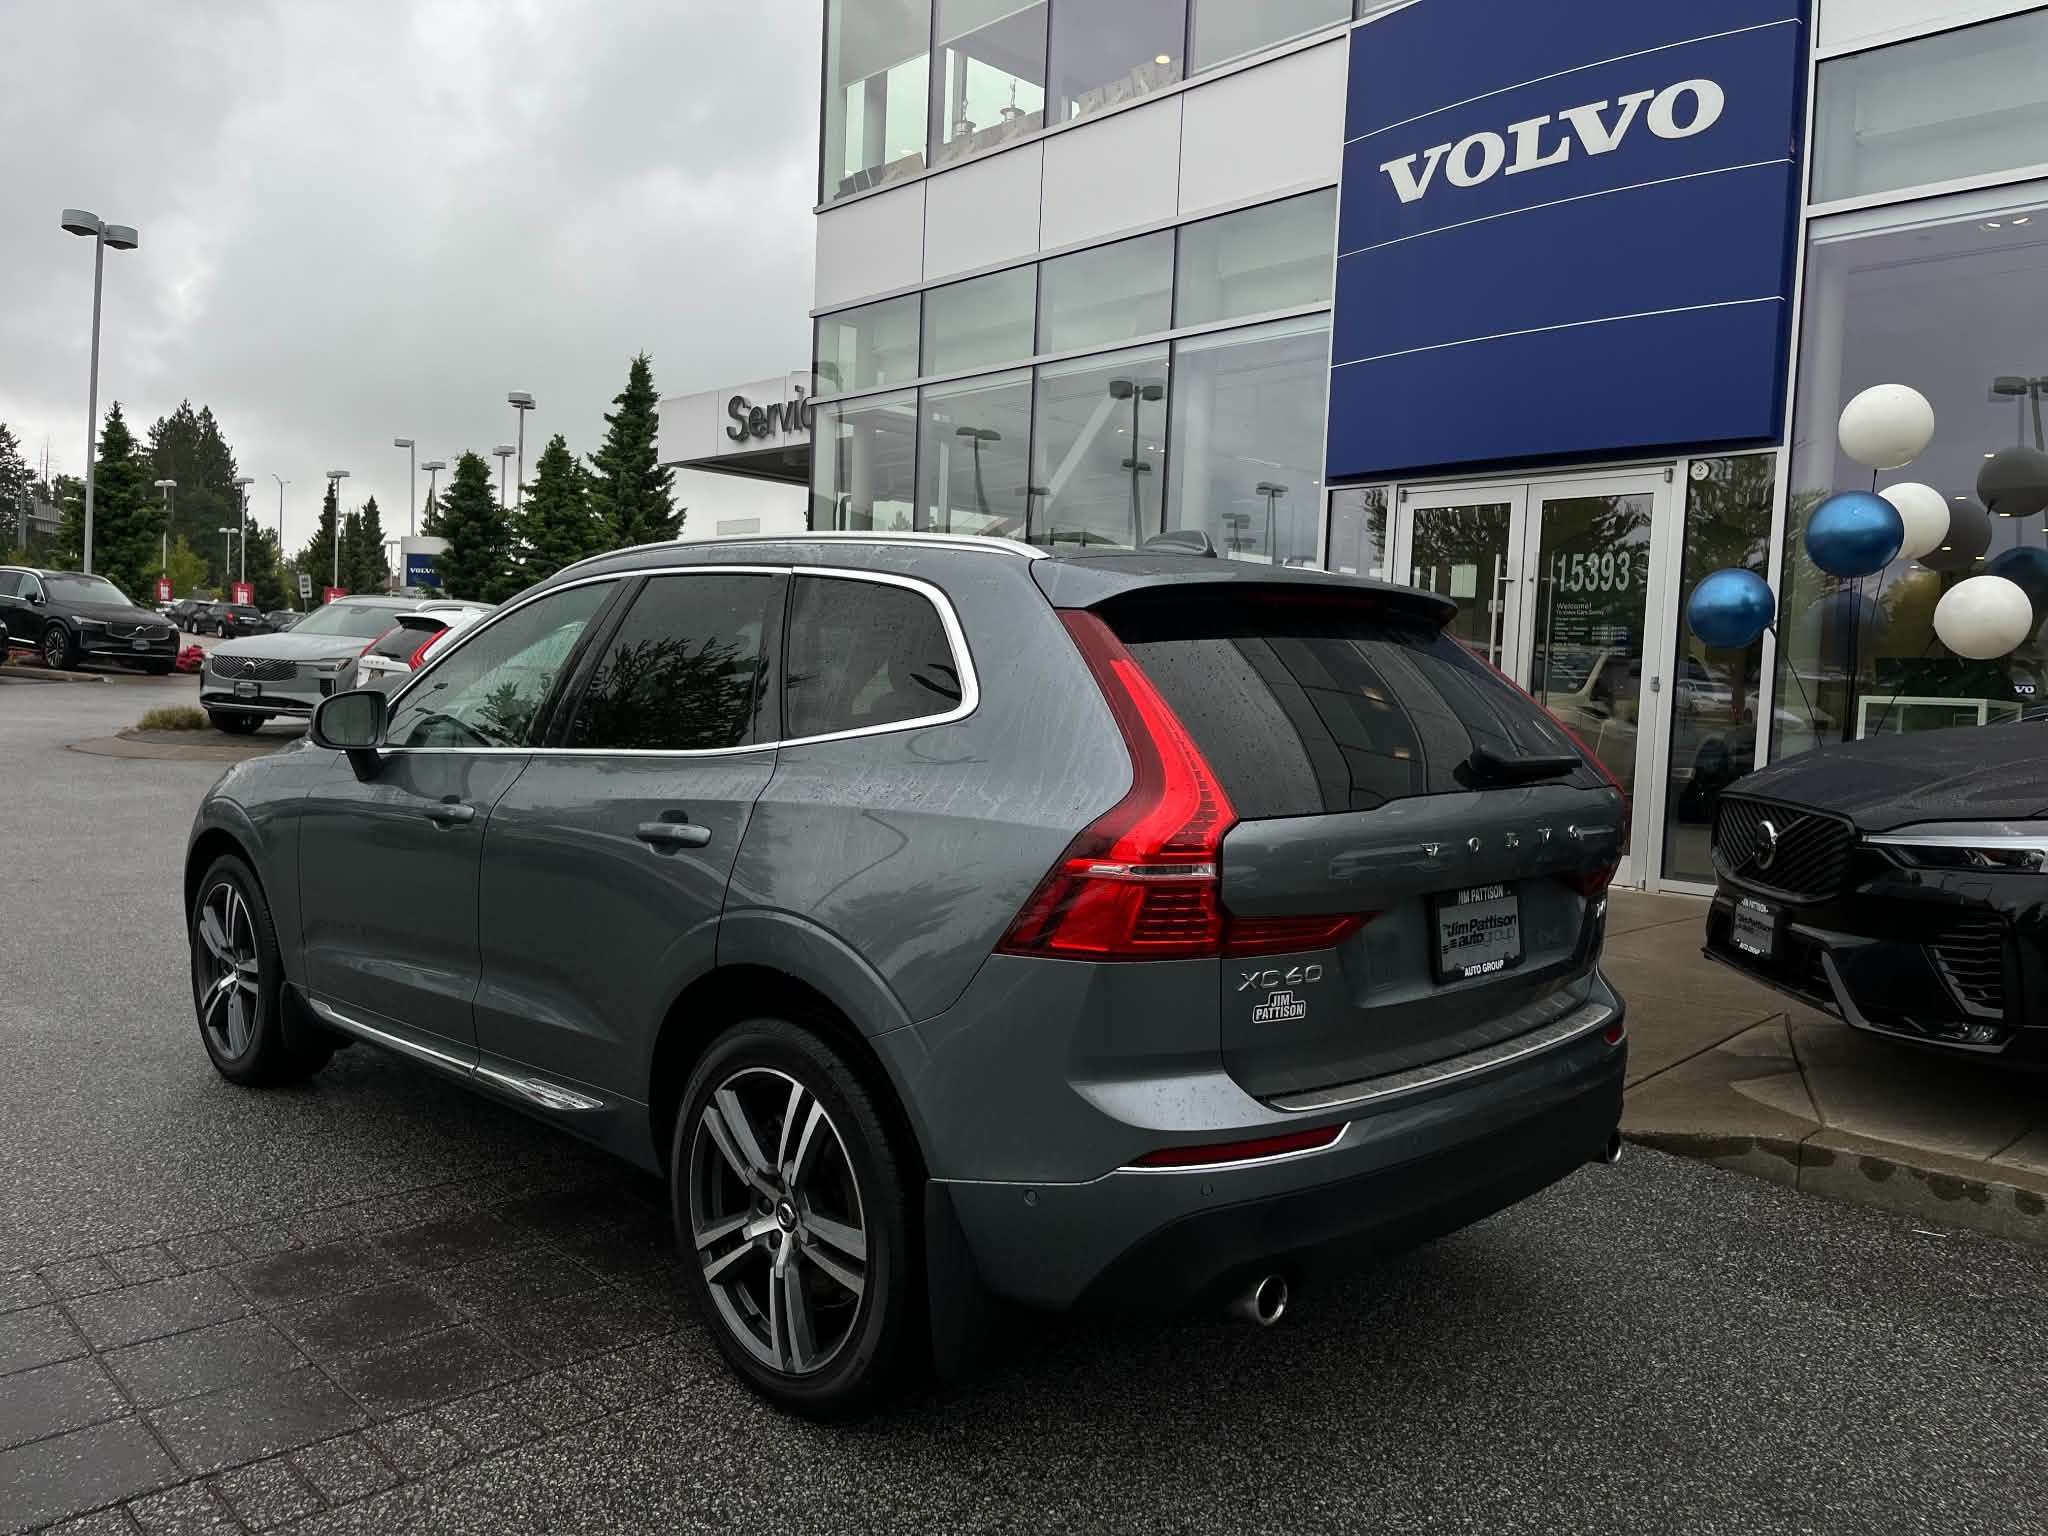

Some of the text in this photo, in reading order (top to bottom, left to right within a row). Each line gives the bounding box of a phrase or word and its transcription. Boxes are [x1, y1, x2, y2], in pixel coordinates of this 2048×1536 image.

[1379, 79, 1725, 203] VOLVO
[1557, 551, 1631, 592] 15393
[1471, 884, 1504, 902] PATTISON
[1448, 914, 1517, 938] Jim Pattison
[1464, 959, 1504, 977] AUTO GROUP
[1271, 994, 1290, 1007] JIM
[1255, 1003, 1304, 1021] PATTISON
